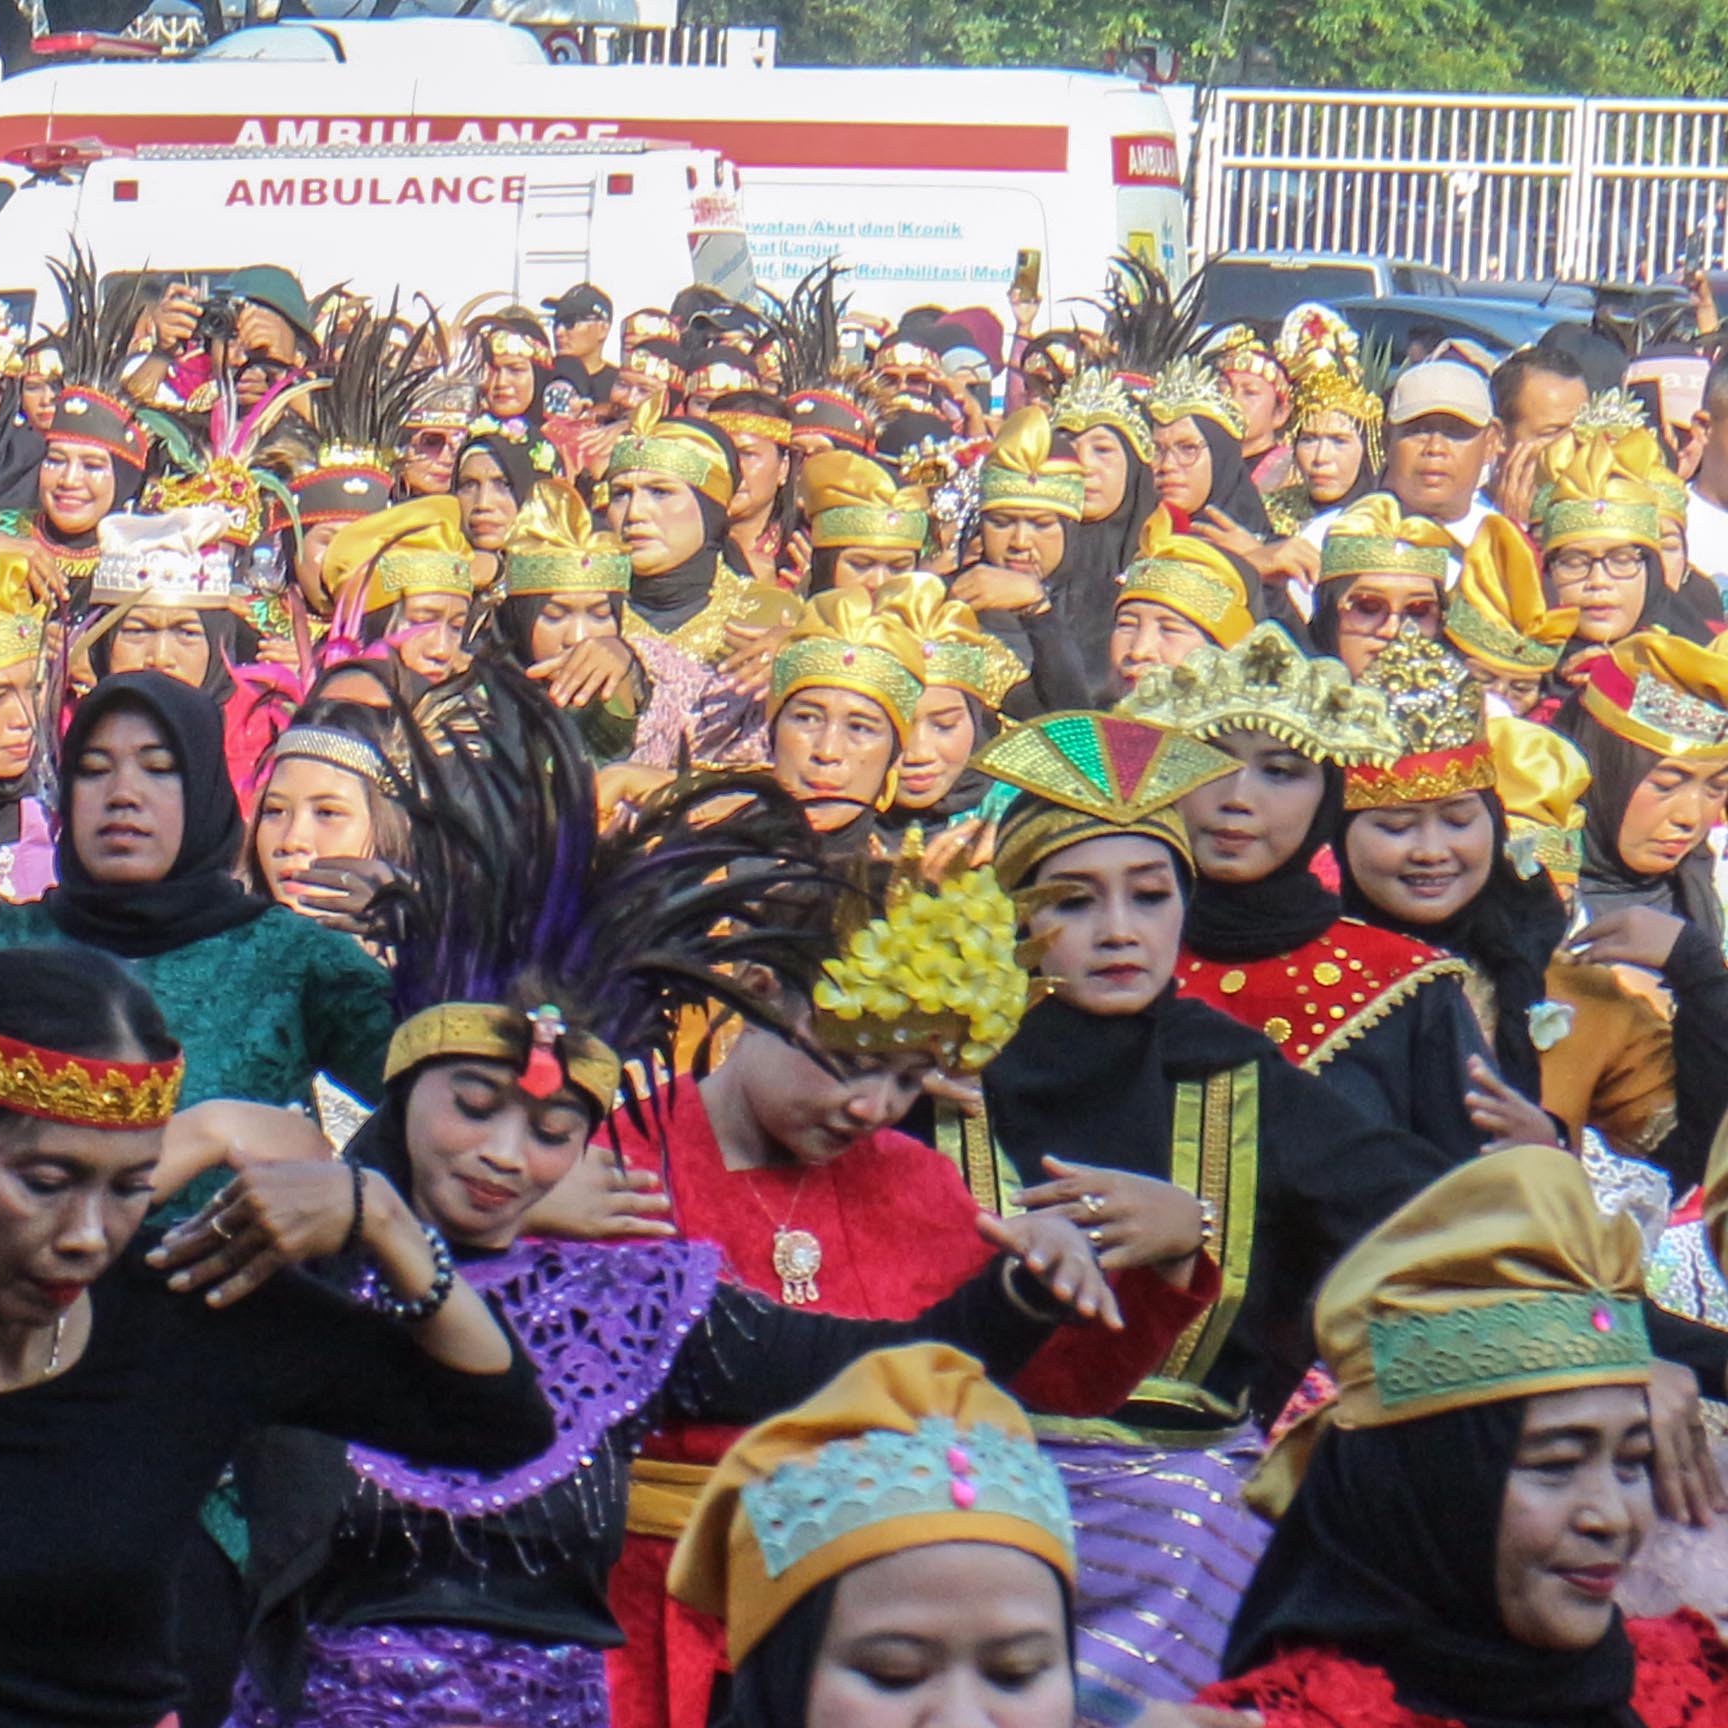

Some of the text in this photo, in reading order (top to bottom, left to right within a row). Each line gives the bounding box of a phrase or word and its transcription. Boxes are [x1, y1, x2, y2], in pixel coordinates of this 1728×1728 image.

[225, 175, 526, 207] AMBULANCE
[900, 222, 962, 238] Kronik
[857, 263, 966, 281] Rehabilitasi
[971, 265, 1012, 282] Med
